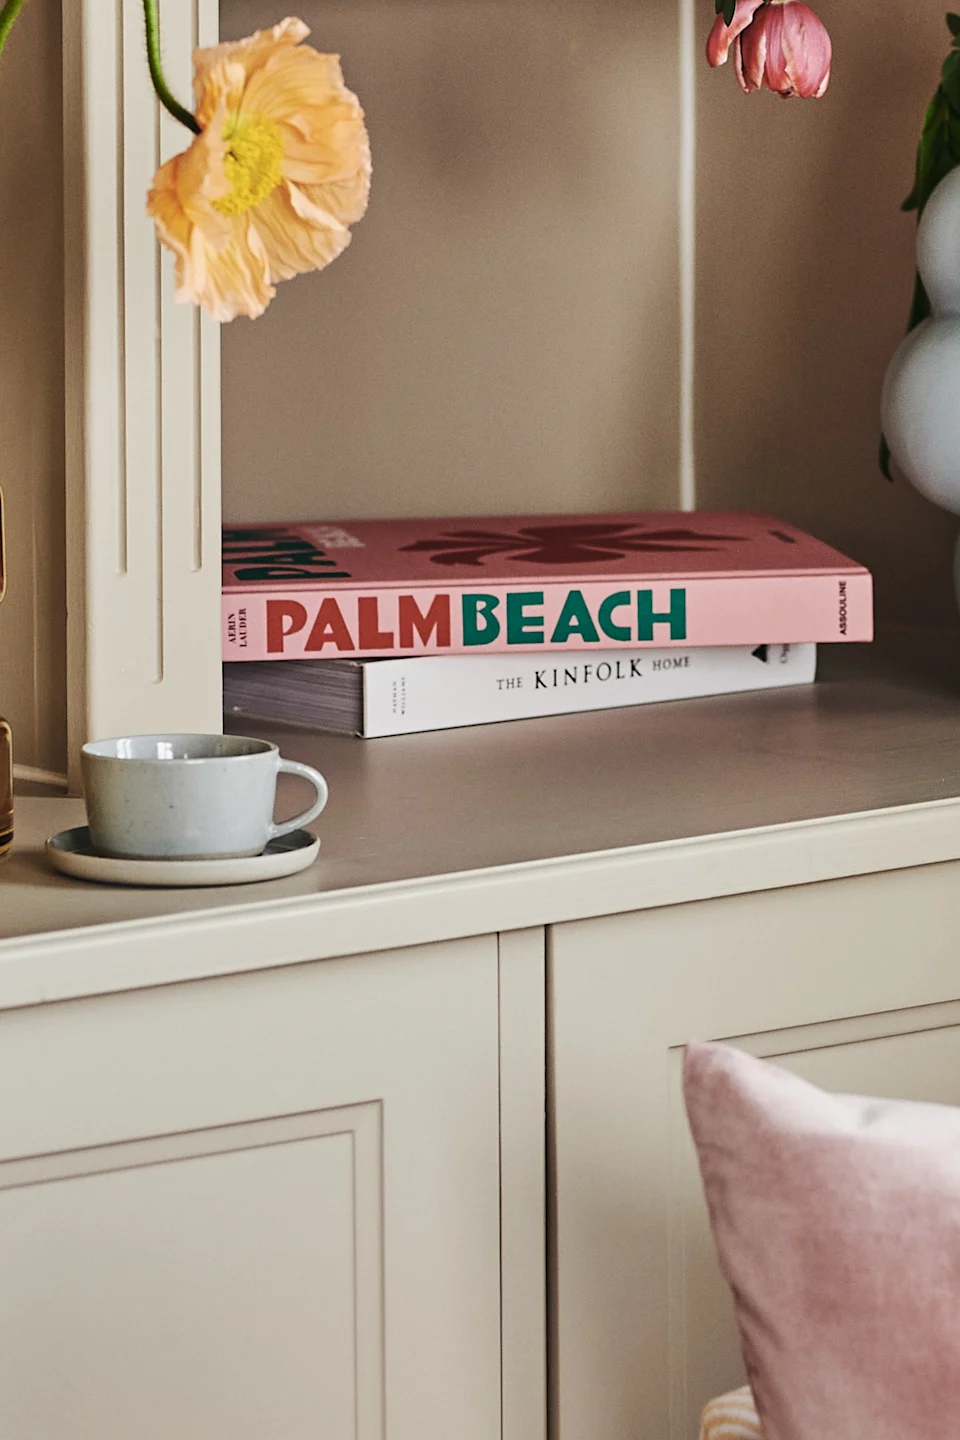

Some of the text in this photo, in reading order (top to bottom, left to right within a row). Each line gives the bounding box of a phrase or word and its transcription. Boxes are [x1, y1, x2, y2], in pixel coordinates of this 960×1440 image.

[838, 580, 848, 636] ASSOULINE
[228, 613, 237, 645] AERIN
[238, 608, 248, 648] LAUDER
[496, 656, 691, 691] THE KINFOLK HOME
